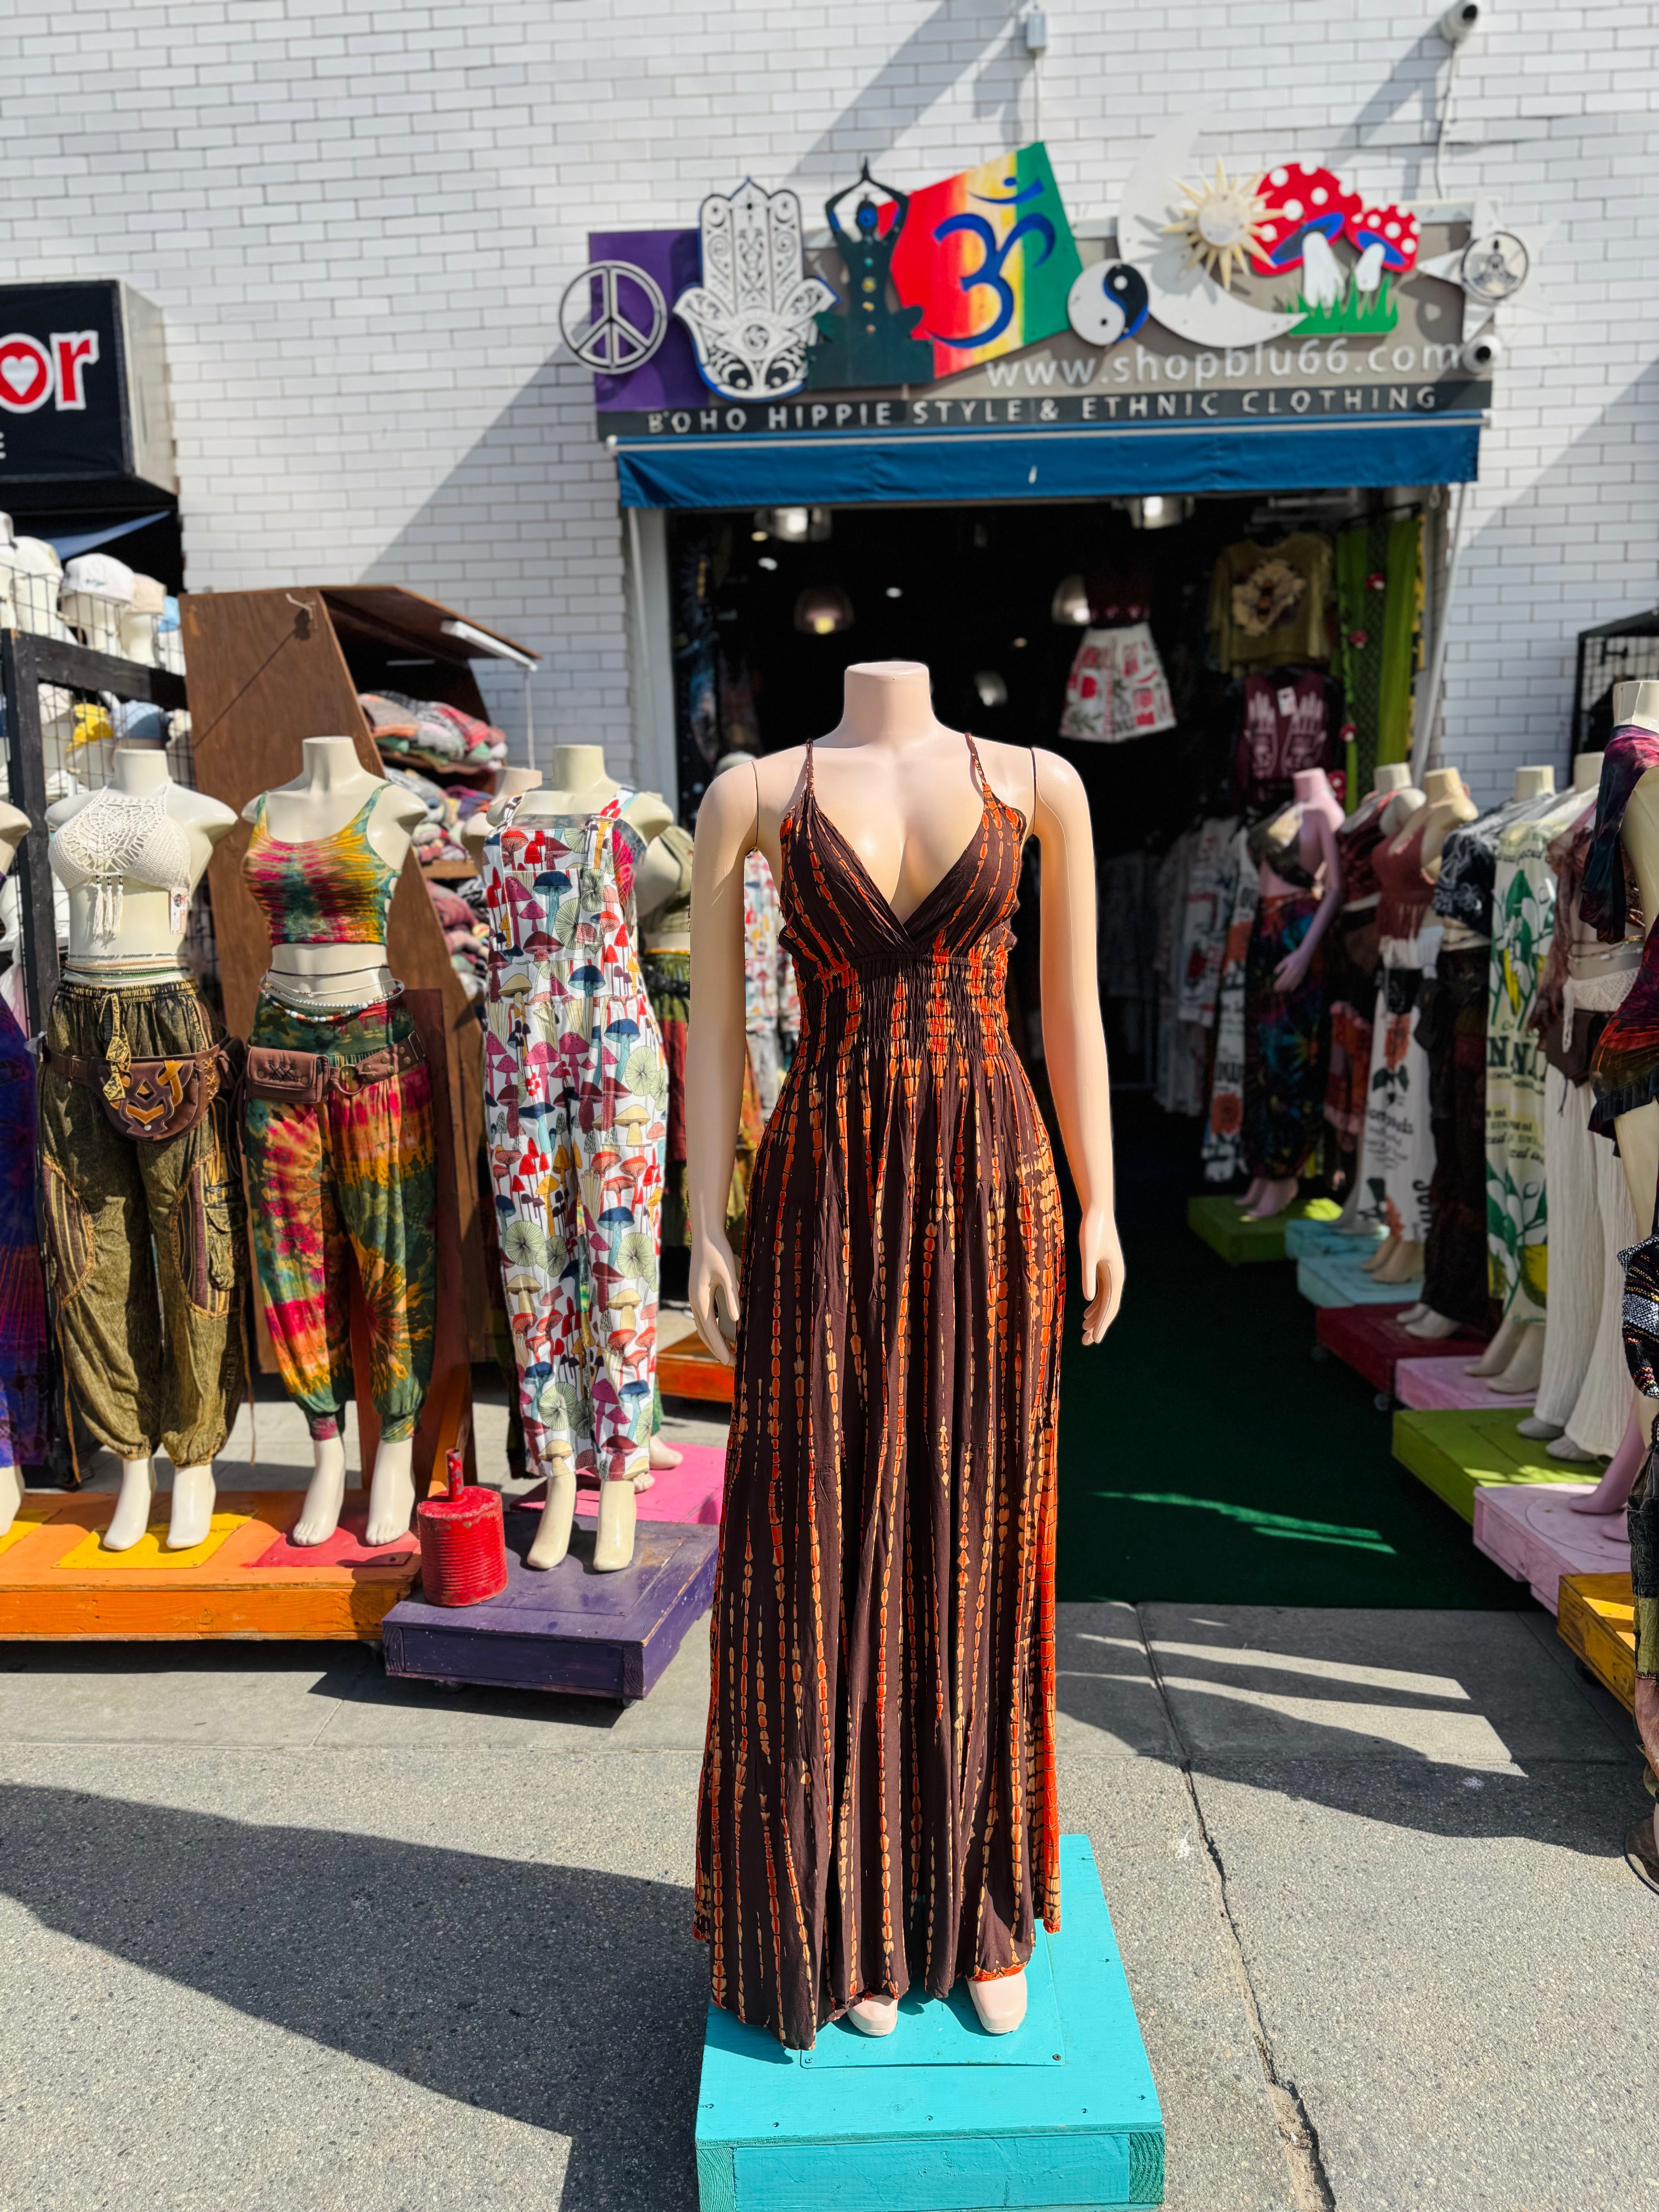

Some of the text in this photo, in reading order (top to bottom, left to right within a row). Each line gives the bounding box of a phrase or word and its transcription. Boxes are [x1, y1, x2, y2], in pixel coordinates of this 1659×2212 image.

[985, 338, 1460, 388] www.shopblu66.com
[648, 387, 1436, 433] BOHO HIPPIE STYLE & ETHNIC CLOTHING
